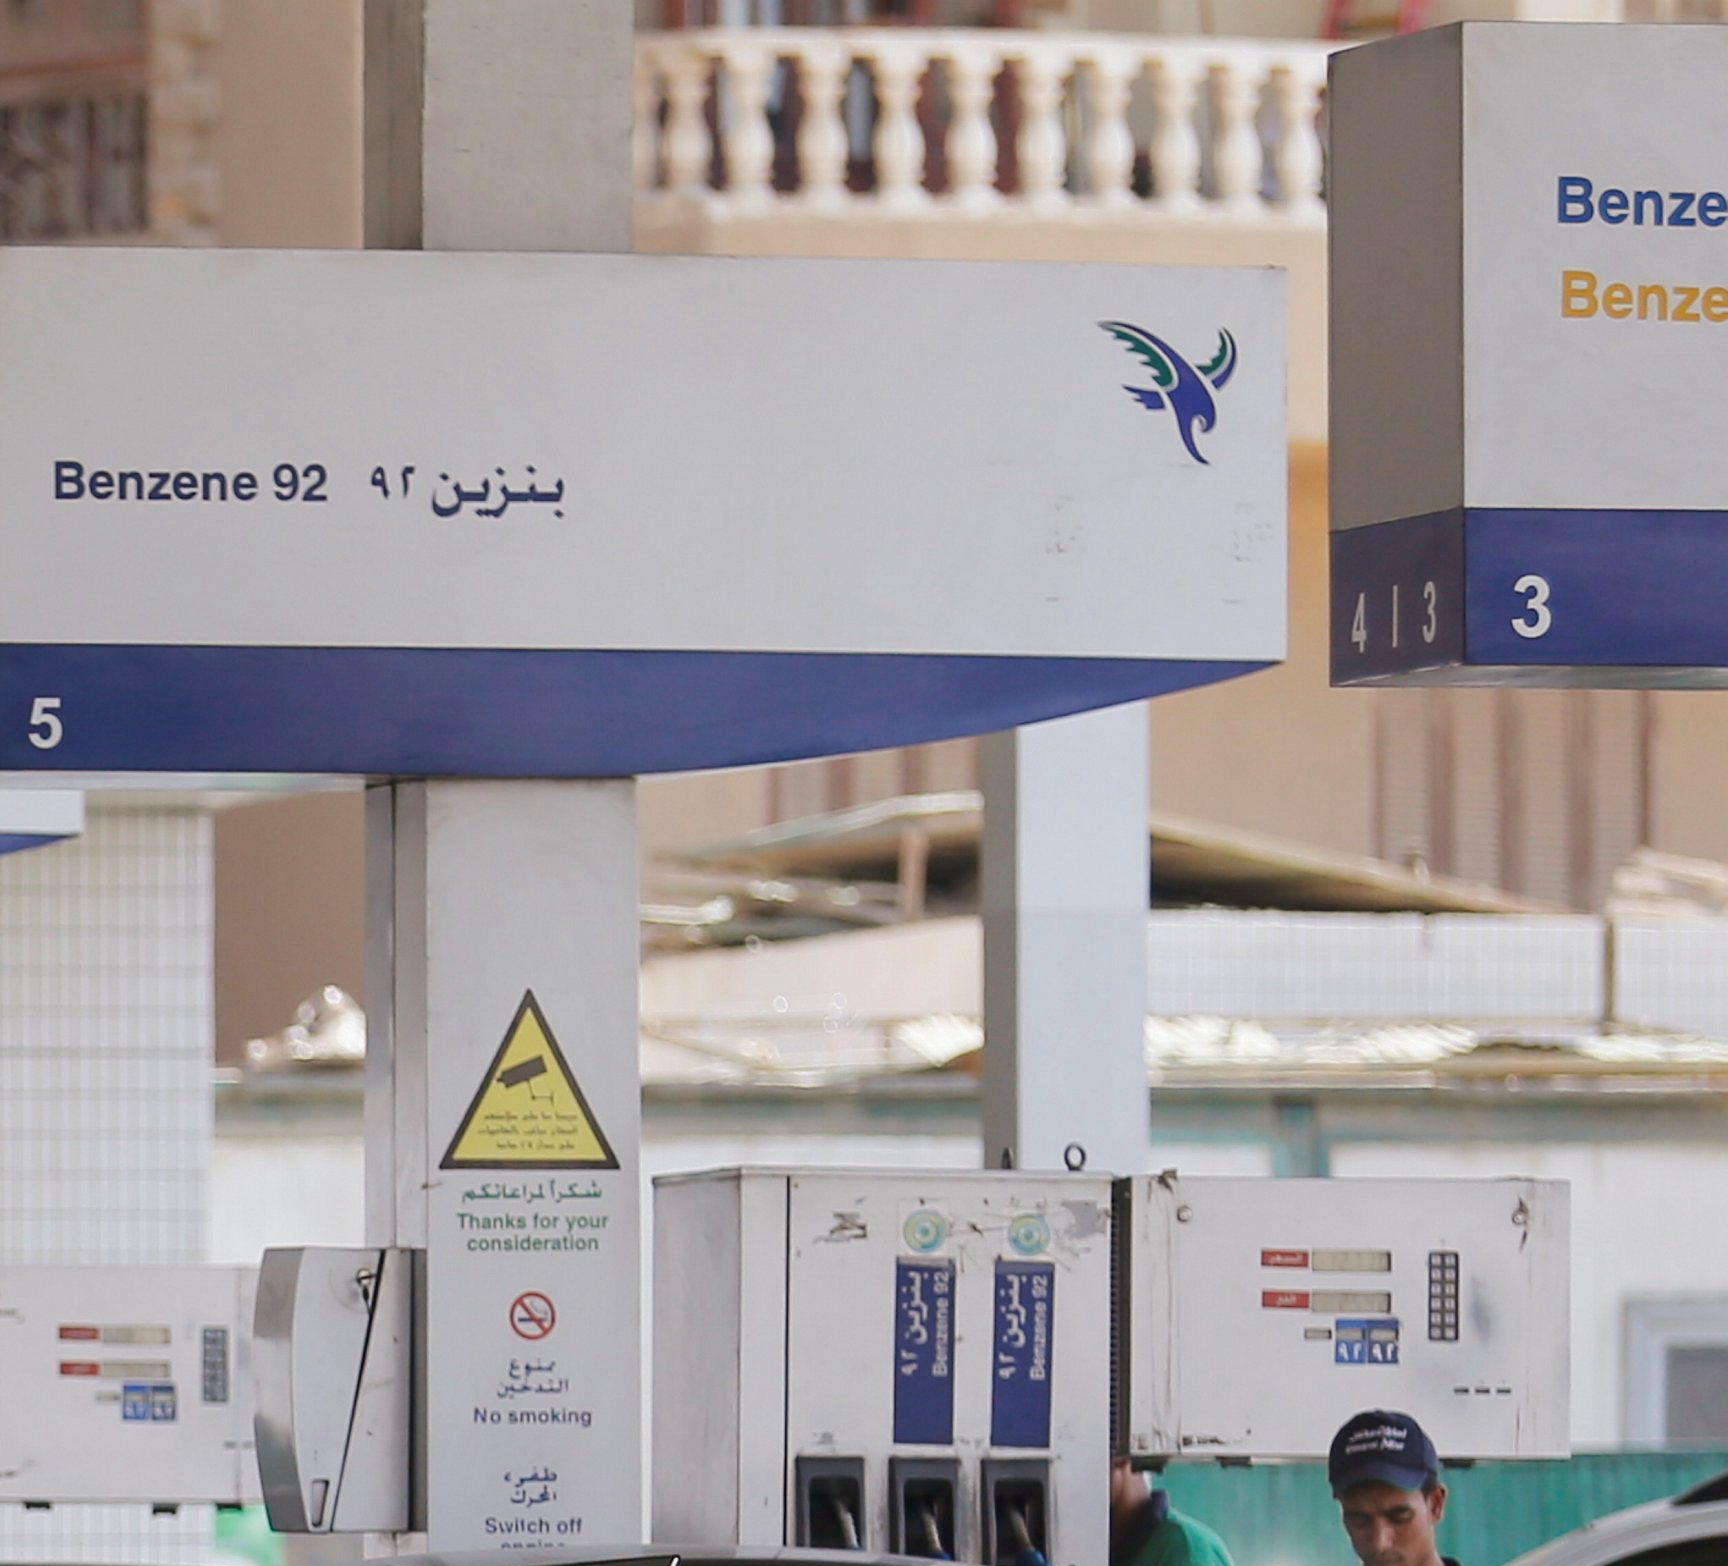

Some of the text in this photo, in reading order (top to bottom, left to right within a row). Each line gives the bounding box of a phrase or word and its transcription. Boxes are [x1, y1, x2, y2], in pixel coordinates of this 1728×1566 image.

[1556, 176, 1728, 227] Benze
[1560, 271, 1728, 322] Benze
[53, 460, 329, 502] Benzene 92
[369, 465, 566, 518] بنزين ٩٢
[1351, 580, 1438, 653] 4 3
[1509, 574, 1554, 639] 3
[27, 697, 64, 750] 5
[456, 1212, 610, 1234] Thanks for your
[467, 1234, 600, 1252] consideration
[473, 1407, 593, 1428] No smoking
[484, 1517, 583, 1535] Switch off
